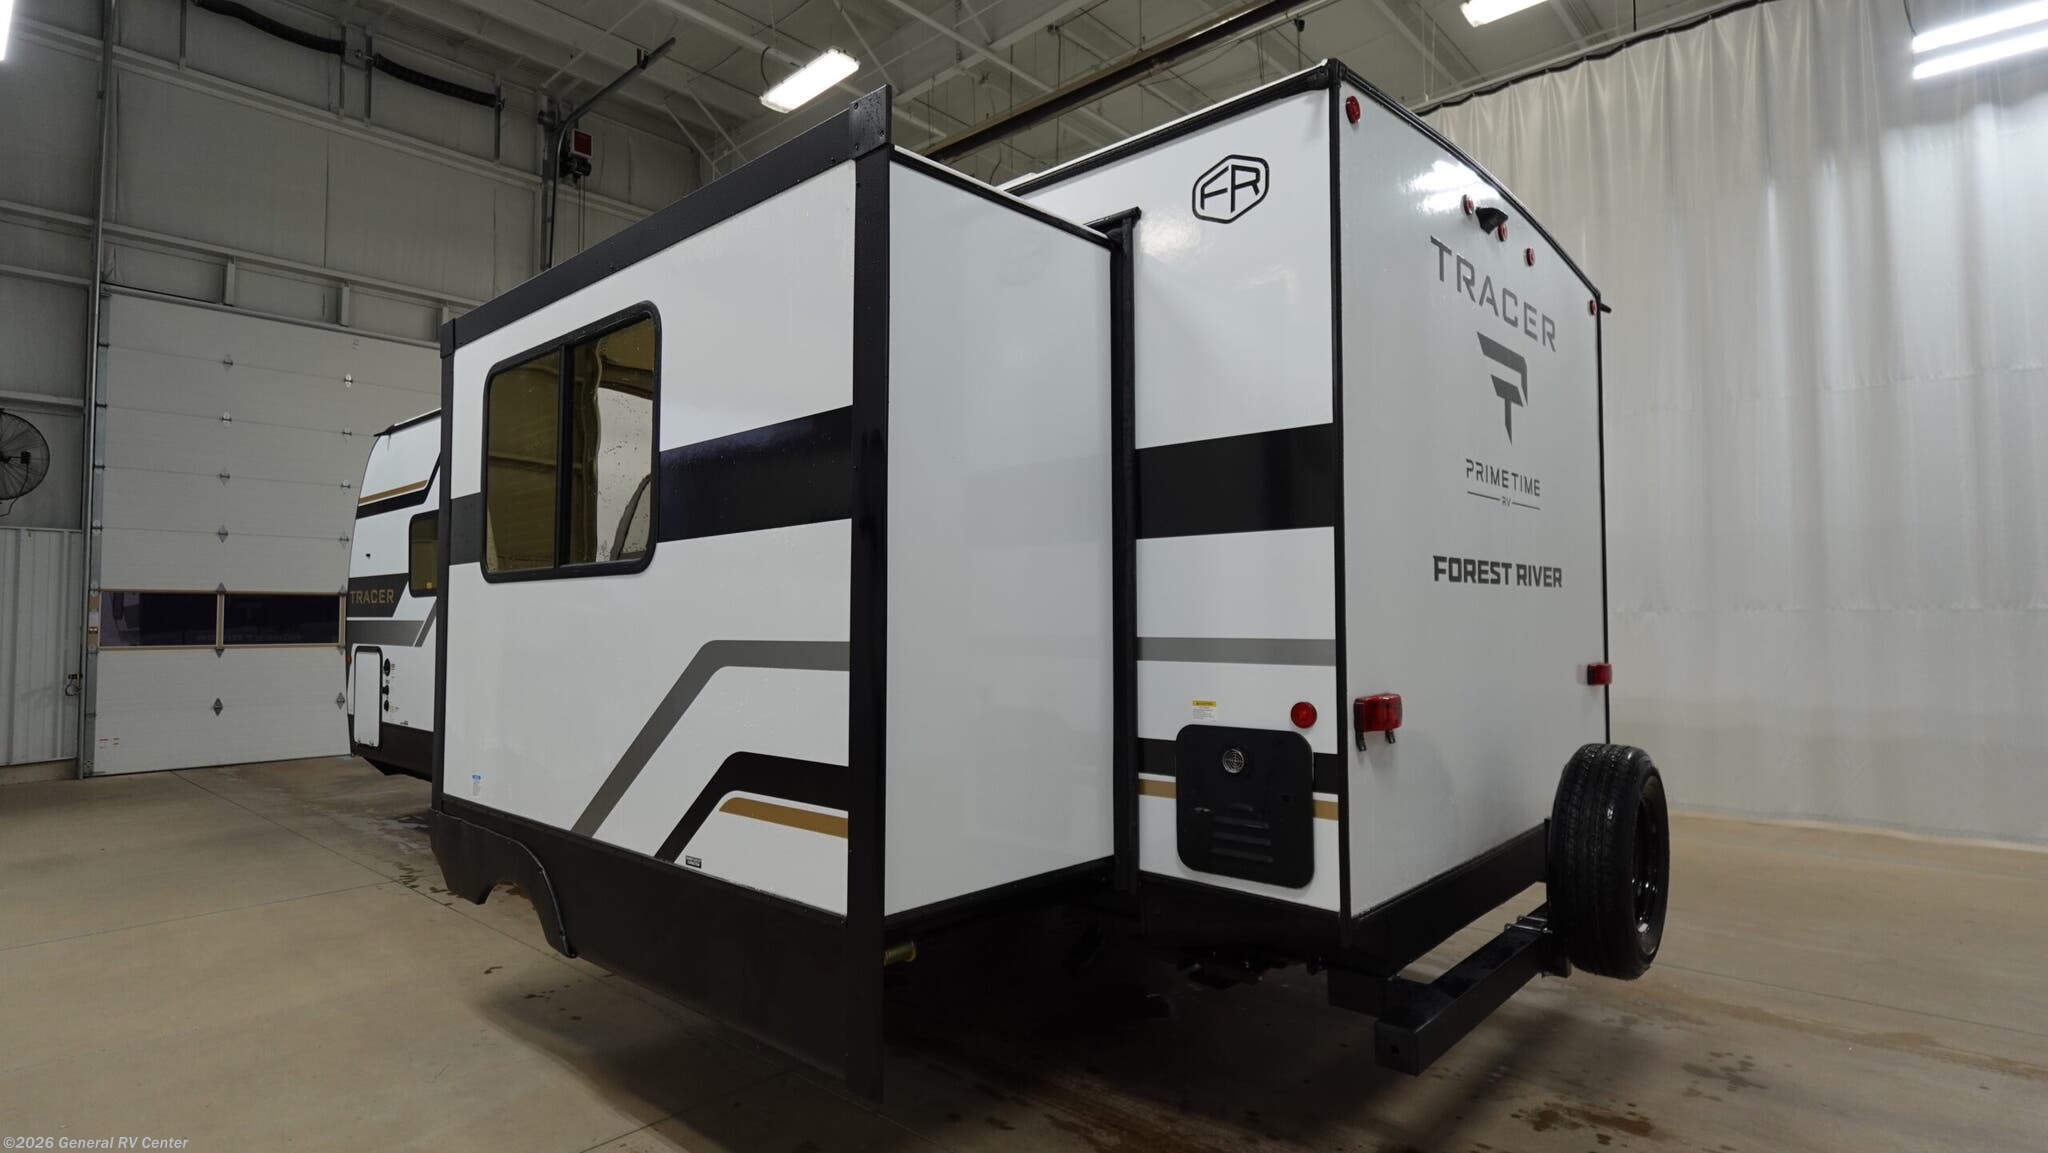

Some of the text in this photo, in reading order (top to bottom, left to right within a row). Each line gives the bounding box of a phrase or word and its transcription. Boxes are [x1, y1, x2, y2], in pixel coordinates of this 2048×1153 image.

[1430, 235, 1556, 352] TRACER
[1433, 555, 1562, 588] FOREST RIVER
[351, 588, 394, 604] TRACER
